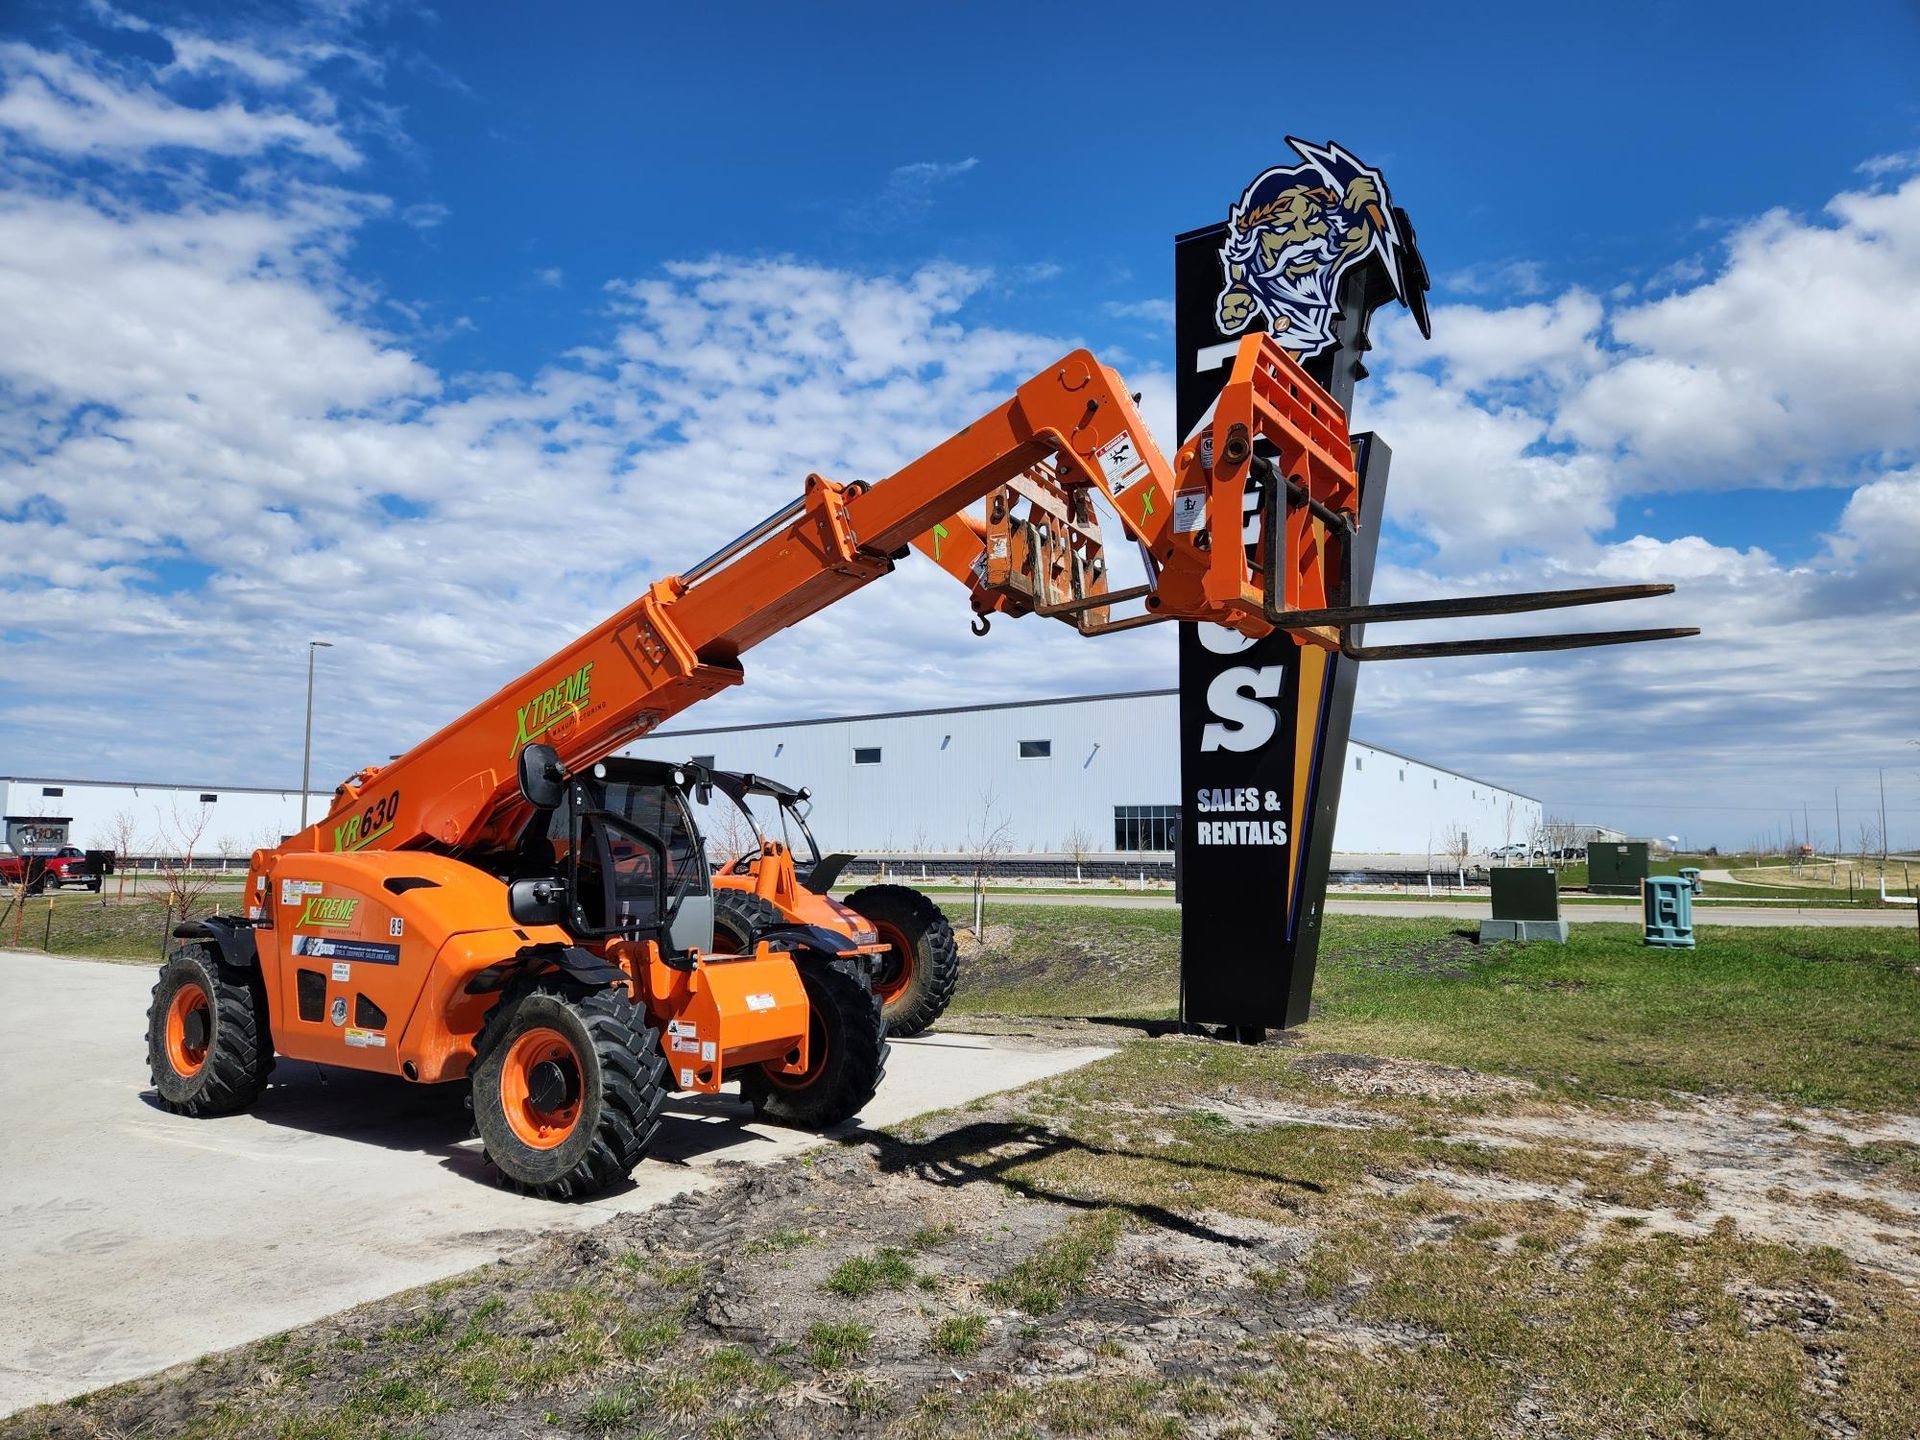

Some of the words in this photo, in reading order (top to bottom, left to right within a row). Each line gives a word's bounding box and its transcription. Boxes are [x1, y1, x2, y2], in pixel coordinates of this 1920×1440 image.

[1104, 435, 1125, 452] DANGER
[509, 661, 594, 759] XTREME
[1197, 788, 1260, 812] SALES
[1264, 790, 1281, 811] &
[335, 789, 399, 853] XR630
[1197, 821, 1287, 845] RENTALS
[296, 898, 358, 928] XTREME
[391, 919, 402, 934] 89
